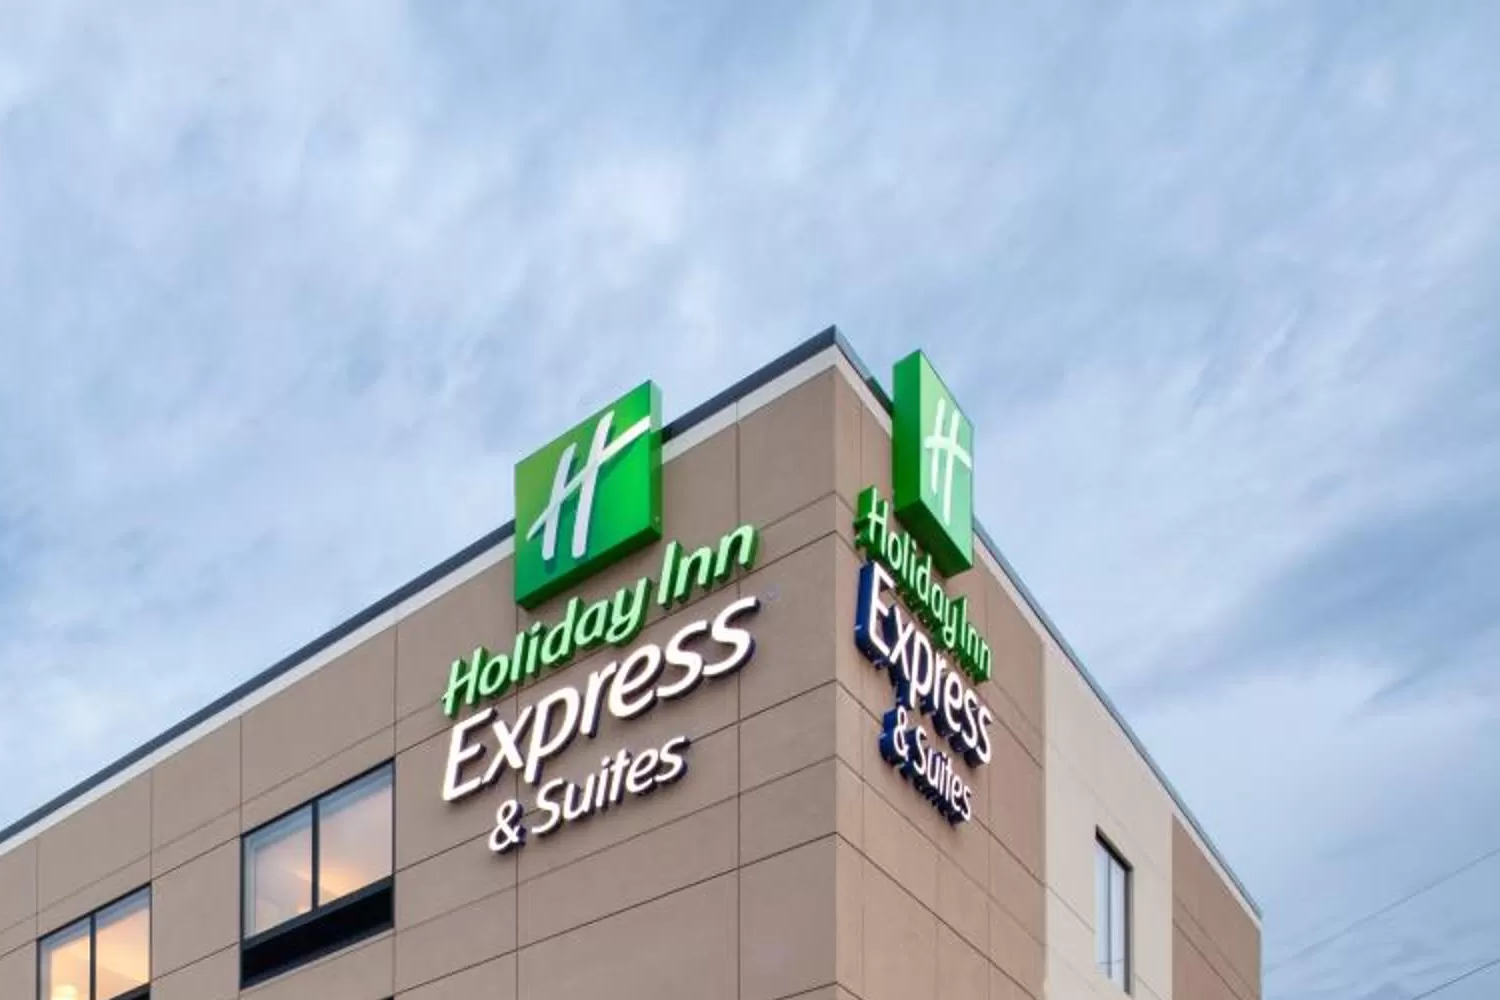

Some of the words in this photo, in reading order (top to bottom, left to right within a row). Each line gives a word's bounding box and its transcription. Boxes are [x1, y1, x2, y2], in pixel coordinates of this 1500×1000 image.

[441, 575, 651, 717] Holiday
[657, 523, 756, 606] Inn
[865, 485, 958, 650] Holiday
[960, 596, 992, 681] Inn
[866, 560, 993, 766] Express
[442, 595, 760, 802] Express
[488, 798, 525, 853] &
[531, 735, 691, 835] Suites
[890, 704, 910, 763] &
[912, 724, 972, 823] Suites
